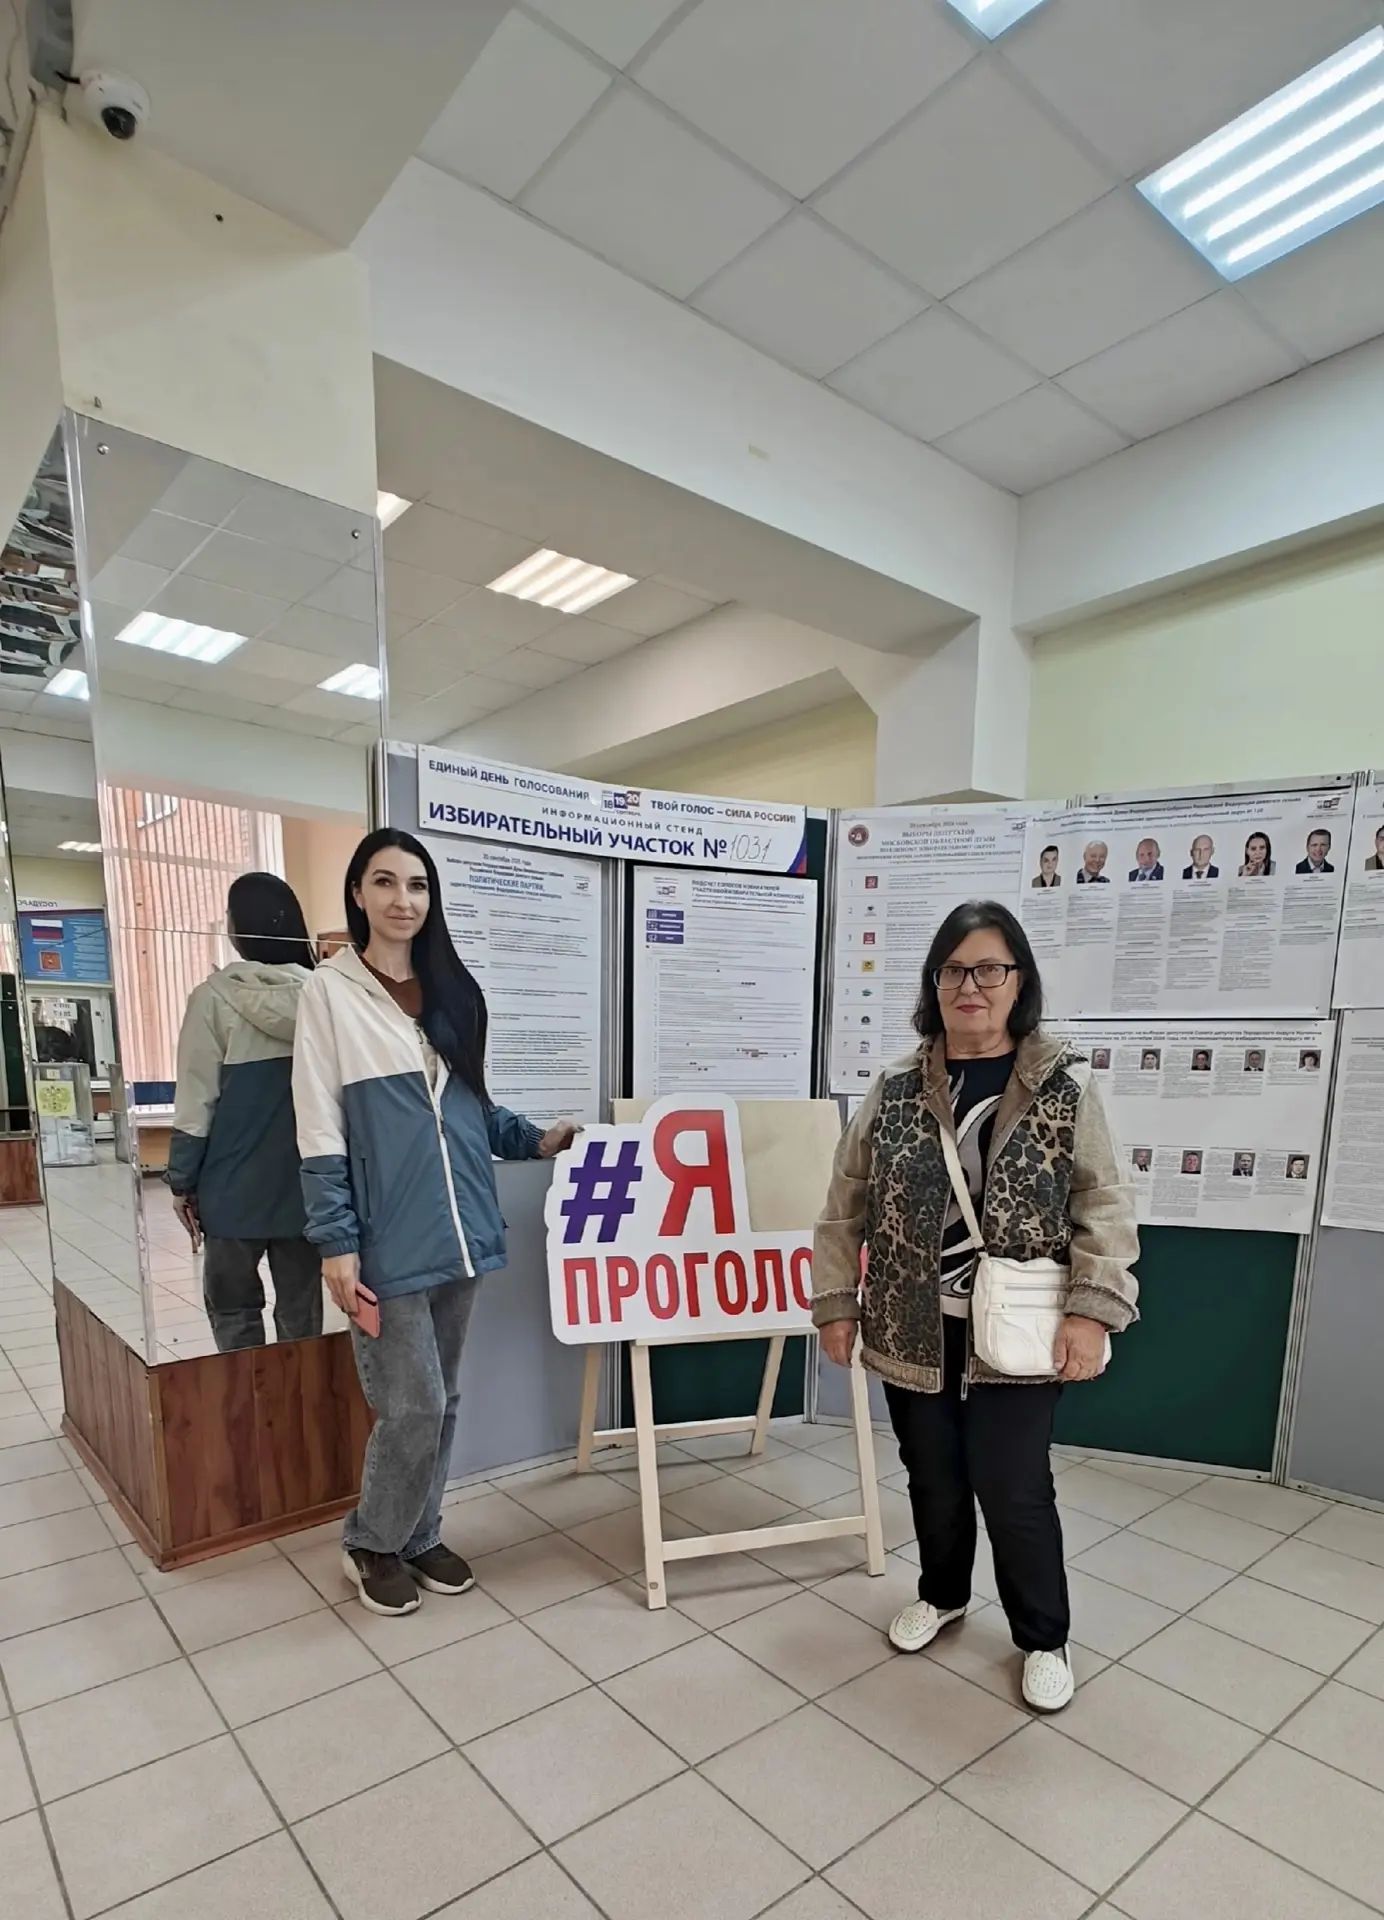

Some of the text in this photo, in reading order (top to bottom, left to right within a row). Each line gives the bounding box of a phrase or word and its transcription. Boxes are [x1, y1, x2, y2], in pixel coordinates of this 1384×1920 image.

[429, 759, 589, 800] ЕДИНЫЙ ДЕНЬ ГОЛОСОВАНИЯ
[542, 806, 704, 836] ИНФОРМАЦИОННЫЙ СТЕНД
[604, 793, 639, 809] 18 19 20
[651, 799, 678, 811] ТВОЙ
[680, 803, 714, 816] ГОЛОС
[725, 808, 751, 819] СИЛА
[754, 811, 796, 823] РОССИИ!
[429, 801, 602, 846] ИЗБИРАТЕЛЬНЫЙ
[608, 832, 695, 857] УЧАСТОК
[703, 838, 727, 859] №
[560, 1109, 736, 1244] #Я
[563, 1246, 814, 1326] ПРОГОЛО
